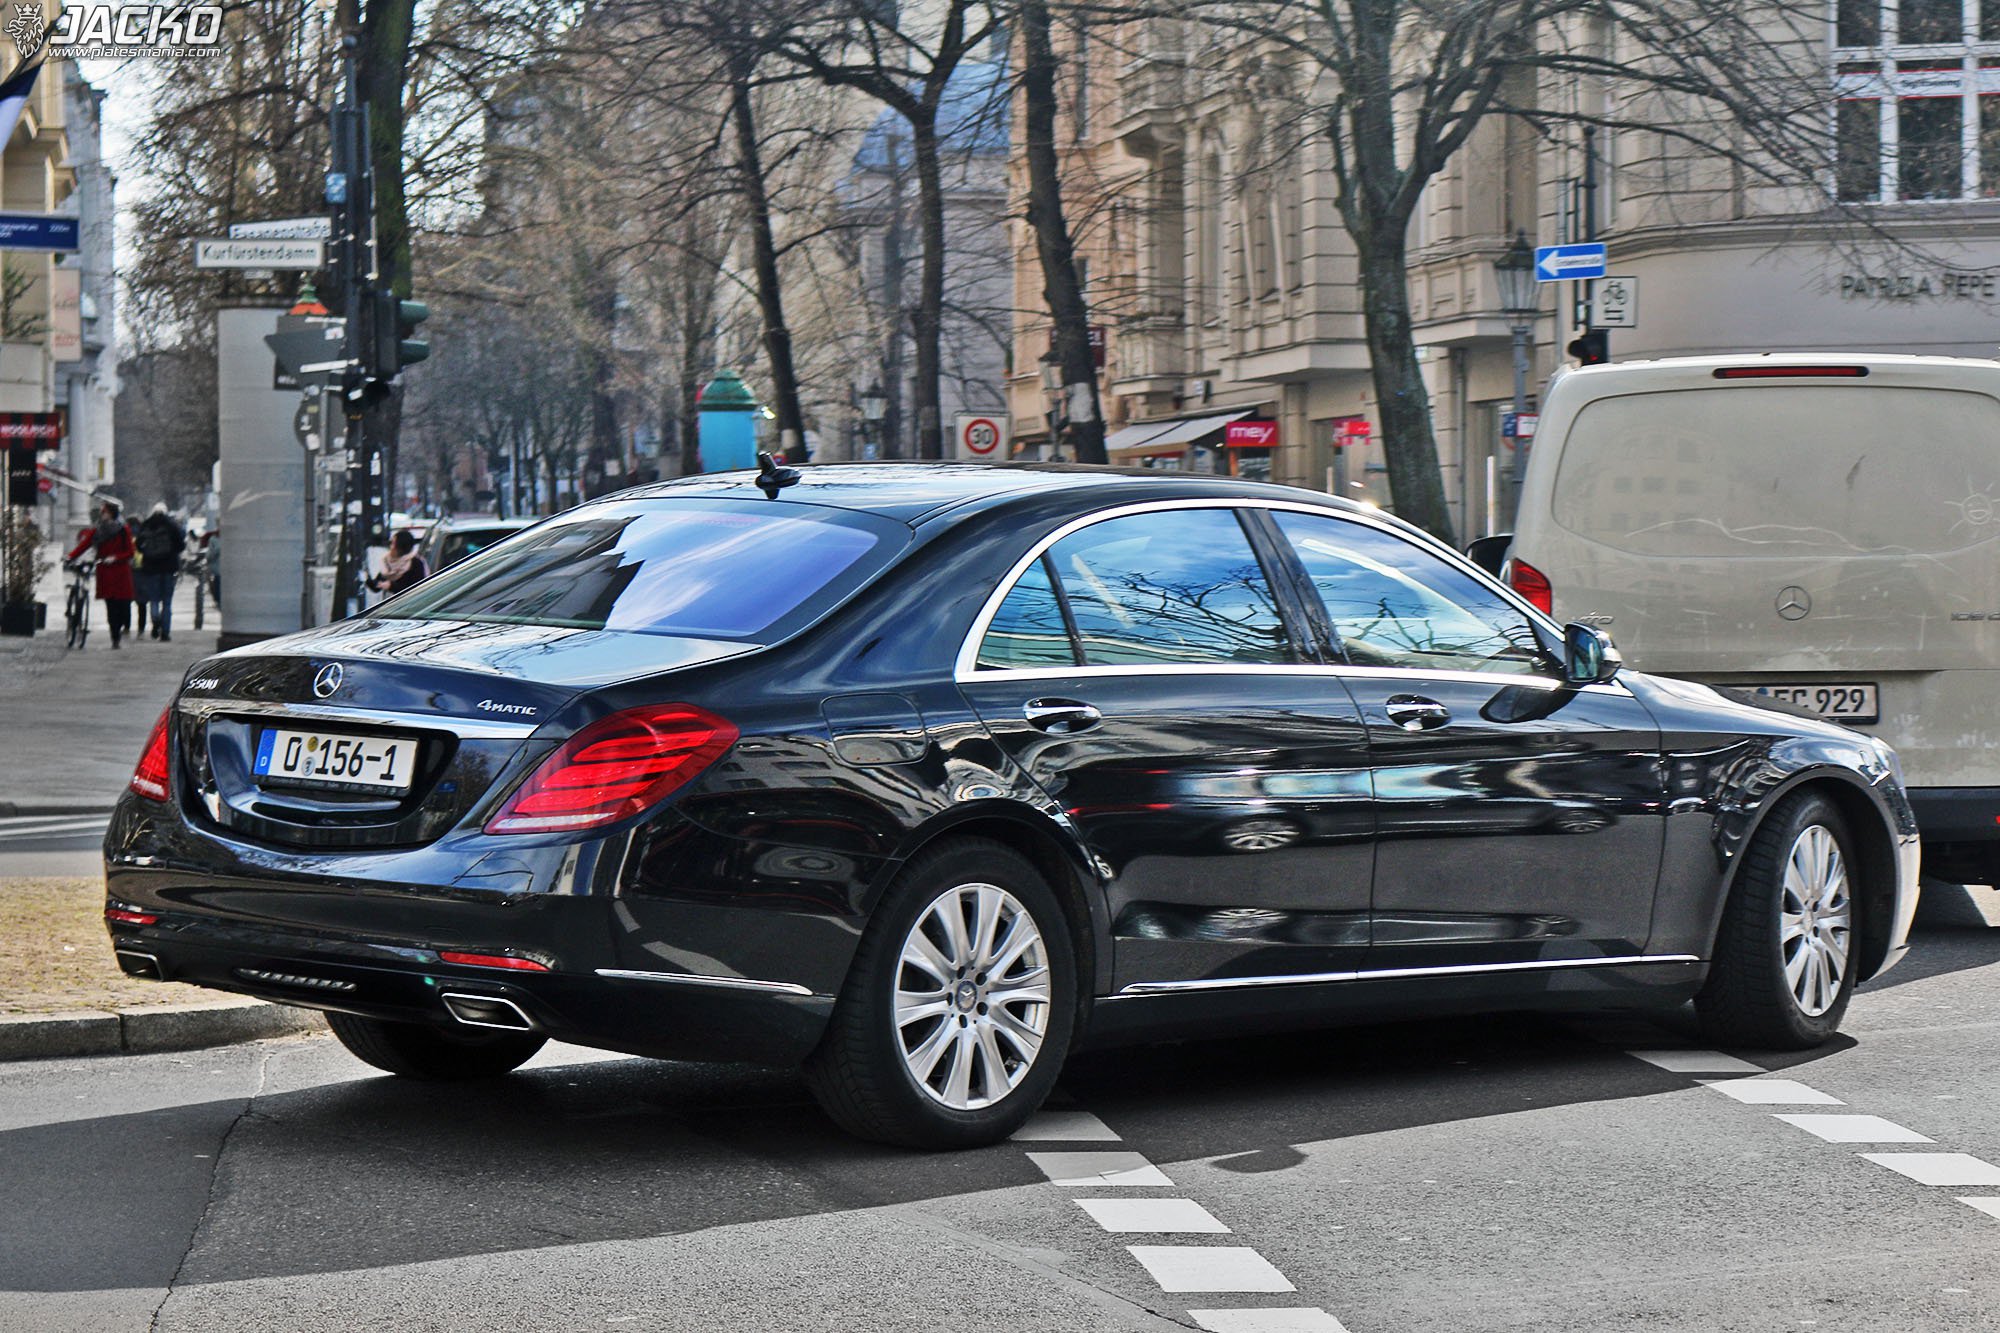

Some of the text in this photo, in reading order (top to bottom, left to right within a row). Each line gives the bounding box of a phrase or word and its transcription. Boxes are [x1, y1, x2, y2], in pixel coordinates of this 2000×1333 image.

[202, 244, 316, 260] Kurfürstendamm
[972, 428, 992, 445] 30
[1230, 426, 1275, 444] mey
[476, 699, 537, 715] 4MATIC
[1816, 688, 1865, 713] 929
[315, 739, 398, 781] 156-1
